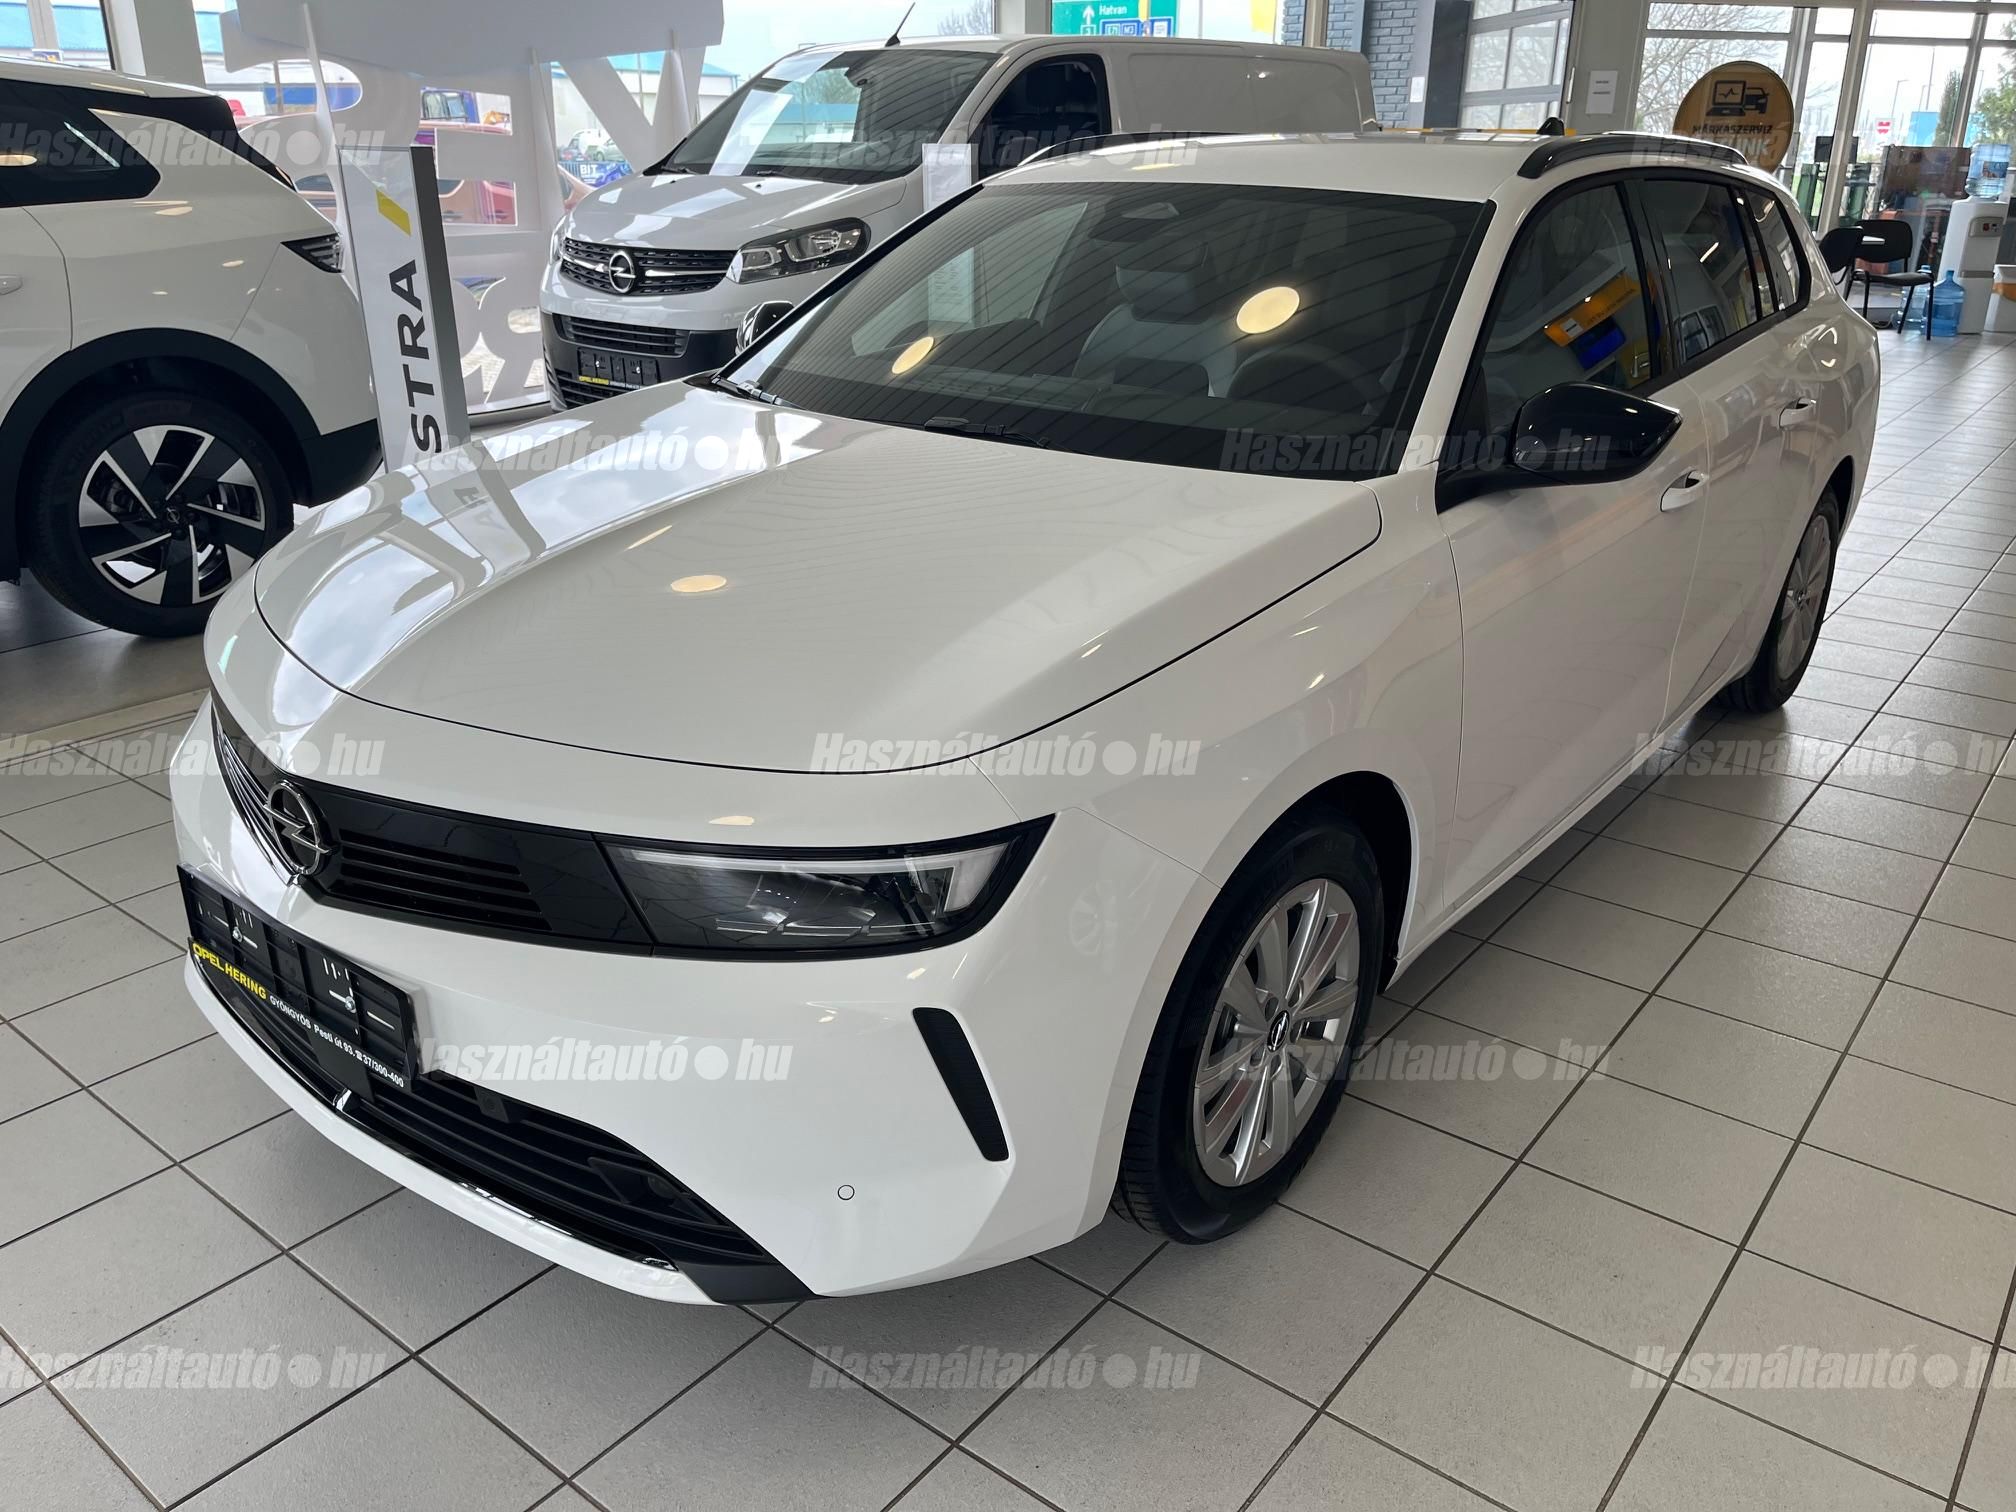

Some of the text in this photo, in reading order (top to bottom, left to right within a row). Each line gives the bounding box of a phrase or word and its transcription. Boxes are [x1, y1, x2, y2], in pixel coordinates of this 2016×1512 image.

[1099, 5, 1128, 16] Hatvan
[580, 164, 598, 175] BIT
[192, 942, 224, 971] OPEL
[225, 962, 267, 999] HERING
[313, 1023, 334, 1043] Pesti
